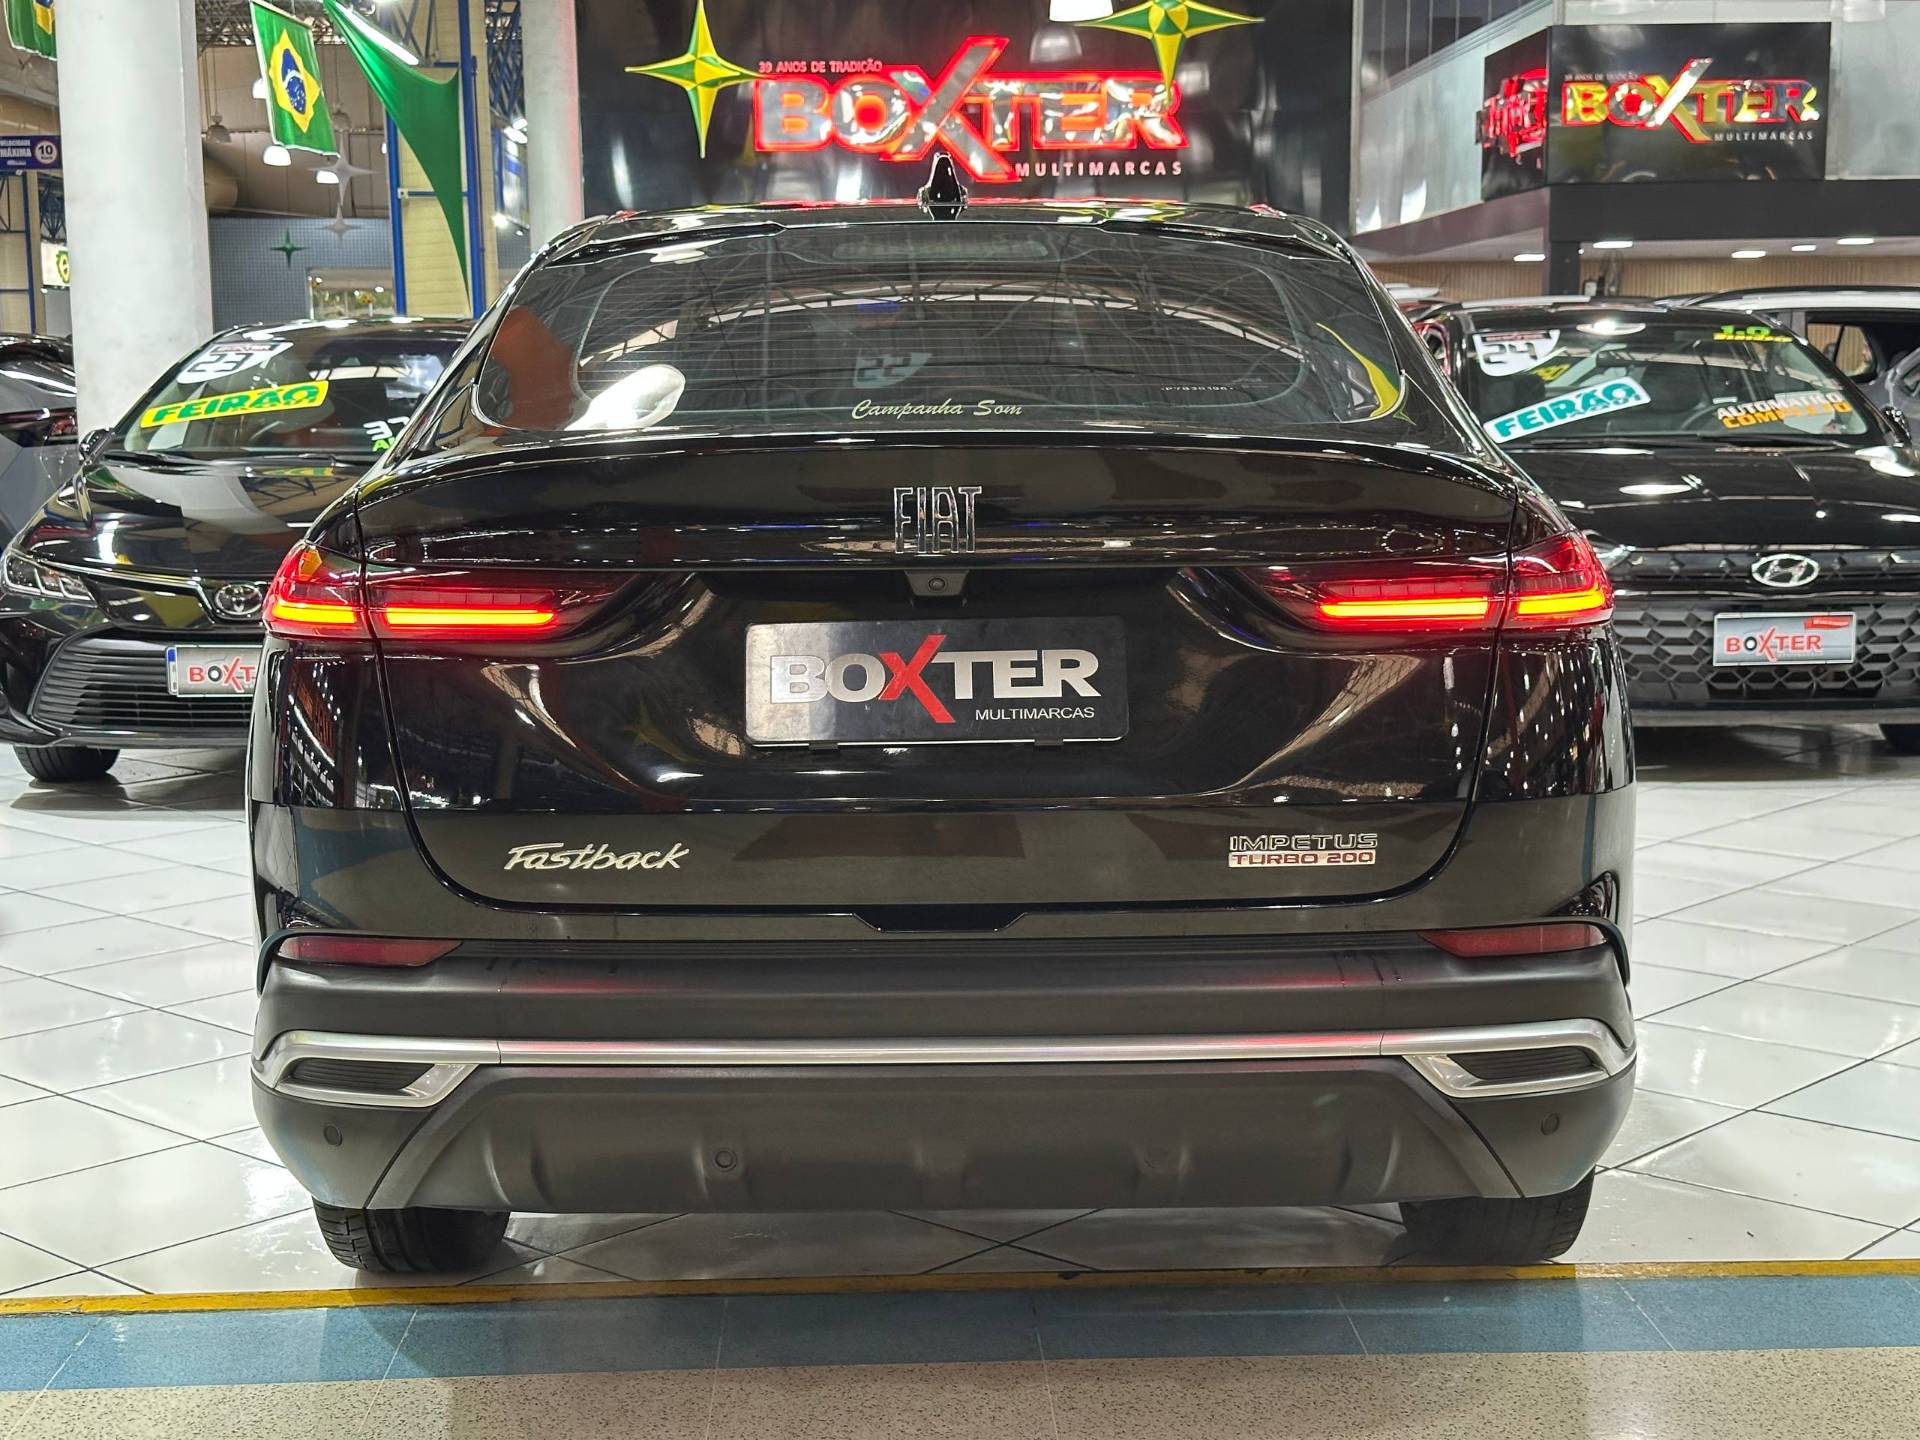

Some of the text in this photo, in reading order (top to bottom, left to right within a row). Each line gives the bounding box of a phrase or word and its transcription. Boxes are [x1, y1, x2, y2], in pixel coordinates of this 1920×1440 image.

[776, 60, 807, 73] ANOS
[810, 60, 826, 73] DE
[829, 58, 883, 74] TRADIÇÃO
[753, 37, 1190, 183] BOXTER
[1561, 57, 1821, 144] BOXTER
[38, 144, 53, 156] 10
[1713, 130, 1814, 143] MULTIMARCAS
[1014, 160, 1182, 177] MULTIMARCAS
[152, 385, 320, 422] FEIRÃO
[851, 398, 1023, 420] Campanha Som
[1494, 382, 1641, 437] FEIRÃO
[894, 486, 982, 554] FIAT
[1725, 627, 1824, 662] BOXTER
[188, 657, 256, 693] BOXT
[770, 634, 1101, 723] BOXTER
[975, 706, 1095, 721] MULTIMARCAS
[1229, 833, 1378, 850] IMPETUS
[503, 842, 690, 870] Fastback
[1232, 852, 1374, 865] TURBO 200
